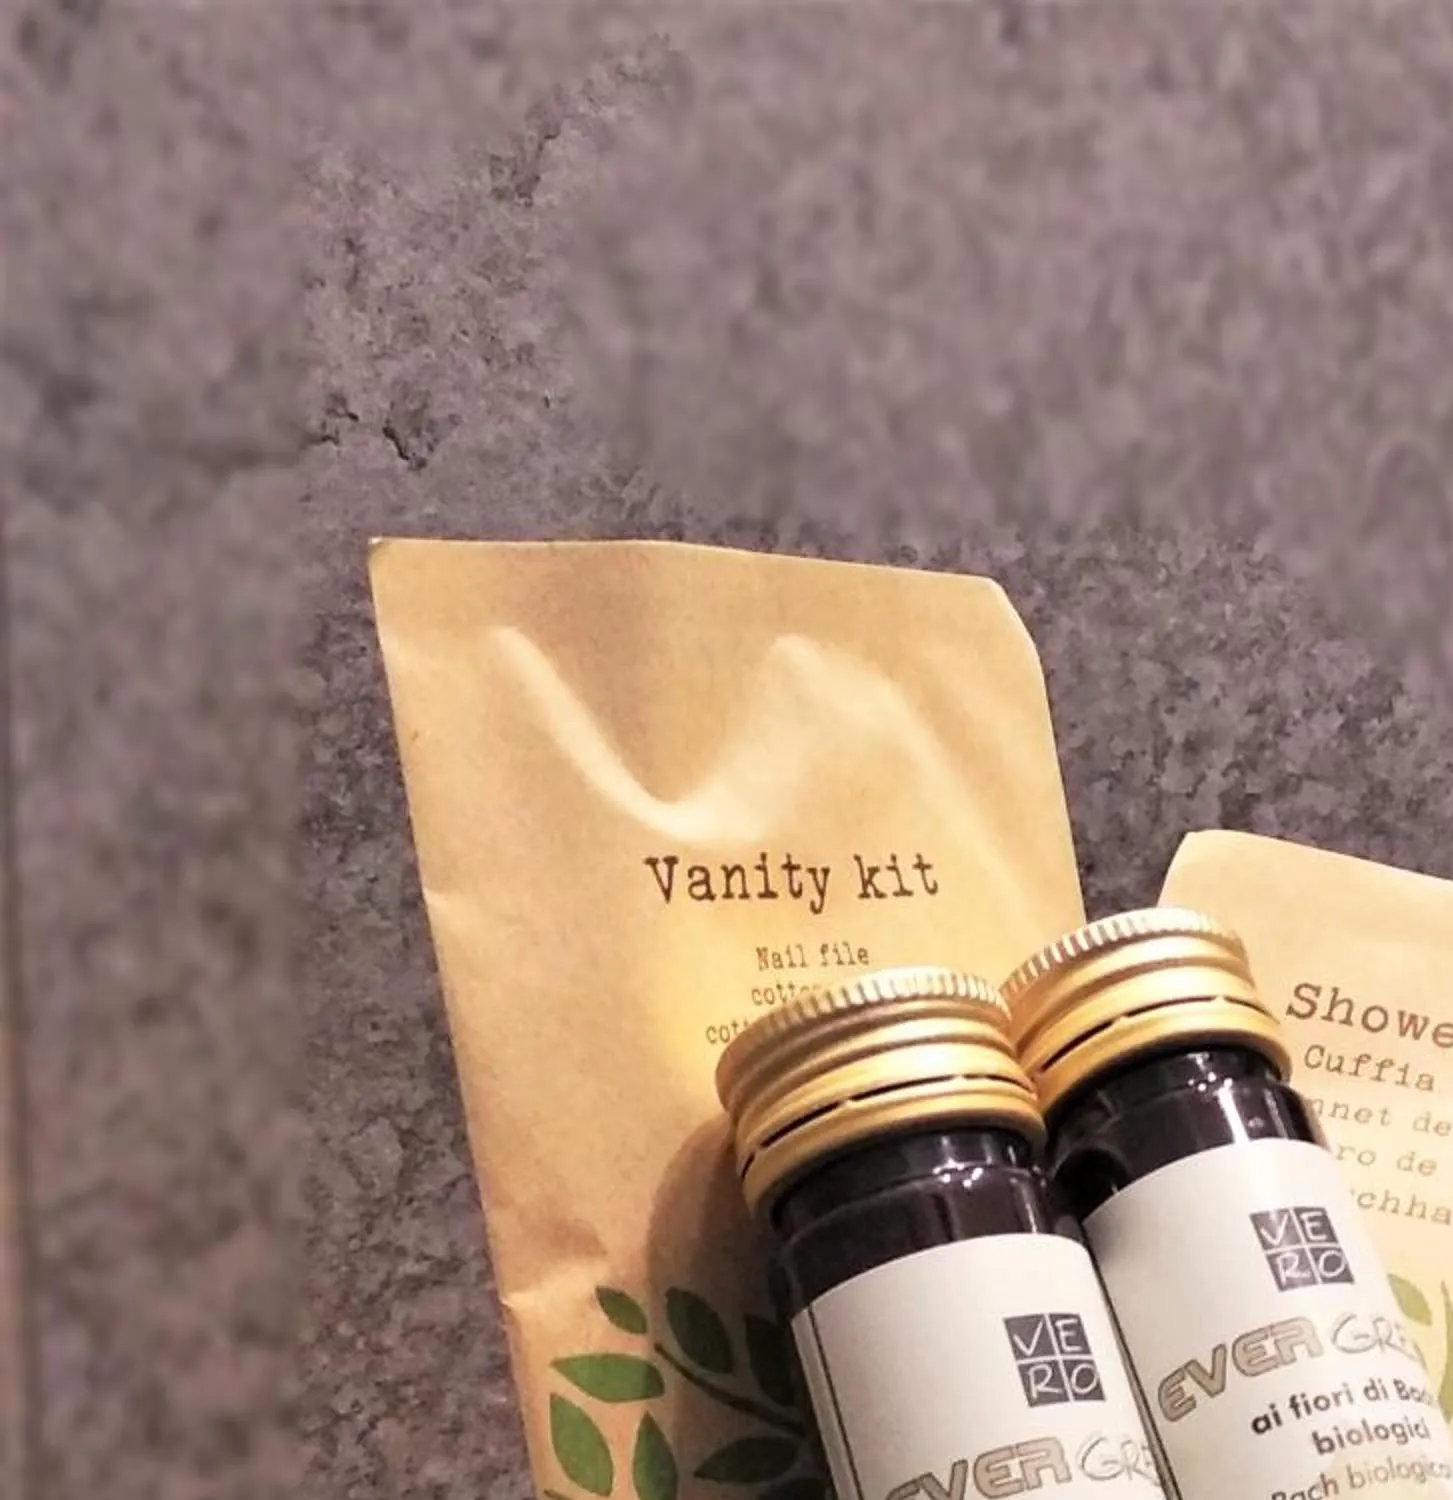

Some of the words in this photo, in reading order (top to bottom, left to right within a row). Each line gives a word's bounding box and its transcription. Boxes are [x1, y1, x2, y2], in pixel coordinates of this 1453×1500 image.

[644, 853, 831, 914] Vanity
[853, 853, 939, 899] kit
[755, 943, 808, 971] Nail
[820, 940, 869, 968] file
[751, 980, 822, 1006] cott
[1303, 1043, 1435, 1093] Cuffia
[1412, 1111, 1452, 1137] de
[1396, 1150, 1437, 1176] de
[1157, 1315, 1326, 1423] EVER
[1251, 1402, 1284, 1435] ai
[1288, 1382, 1355, 1421] fiori
[1362, 1377, 1389, 1401] di
